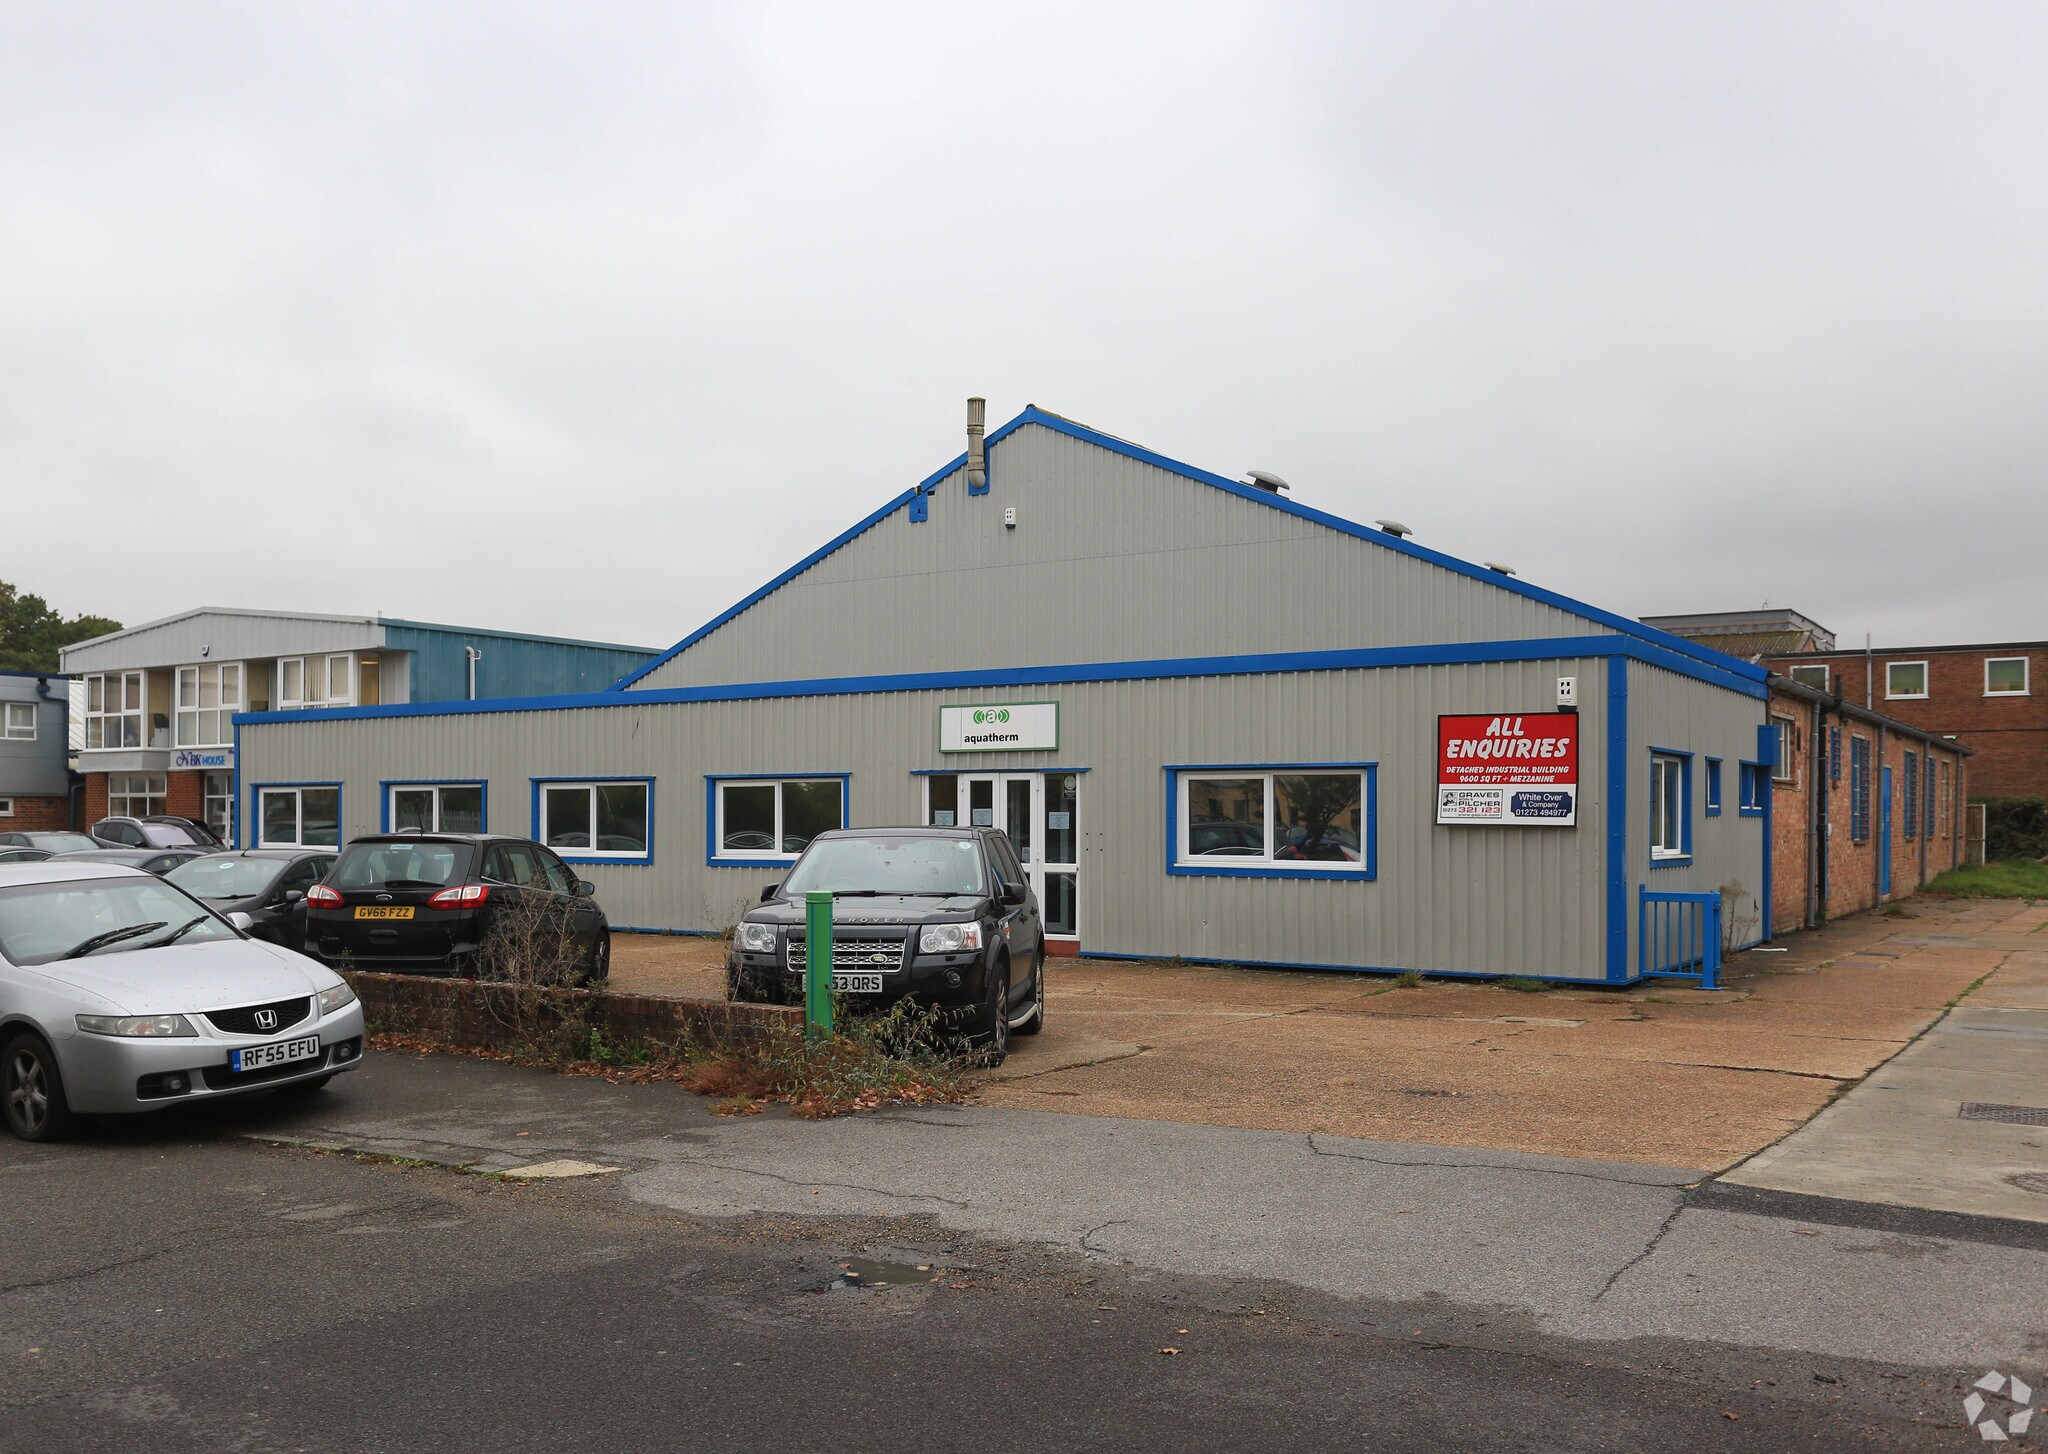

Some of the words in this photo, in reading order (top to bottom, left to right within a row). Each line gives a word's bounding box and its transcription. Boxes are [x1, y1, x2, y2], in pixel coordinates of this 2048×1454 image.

[1486, 717, 1525, 736] ALL
[964, 733, 1019, 744] aquatherm
[1446, 738, 1570, 760] ENQUIRIES
[202, 755, 225, 766] HOUSE
[1446, 766, 1484, 774] DETACHED
[1485, 766, 1530, 774] INDUSTRIAL
[1531, 766, 1570, 774] BUILDING
[1459, 775, 1479, 783] 9600
[1480, 776, 1491, 784] SQ
[1492, 775, 1502, 783] FT
[1510, 775, 1556, 783] MEZZANINE
[1518, 793, 1541, 801] White
[1542, 793, 1563, 801] Over
[1528, 801, 1559, 809] Company
[1515, 808, 1538, 816] 01273
[1539, 808, 1567, 816] 494977
[359, 908, 386, 917] GV66
[388, 908, 410, 918] FZZ
[852, 976, 880, 990] ORS
[244, 1045, 285, 1067] RF55
[288, 1038, 316, 1059] EFU
